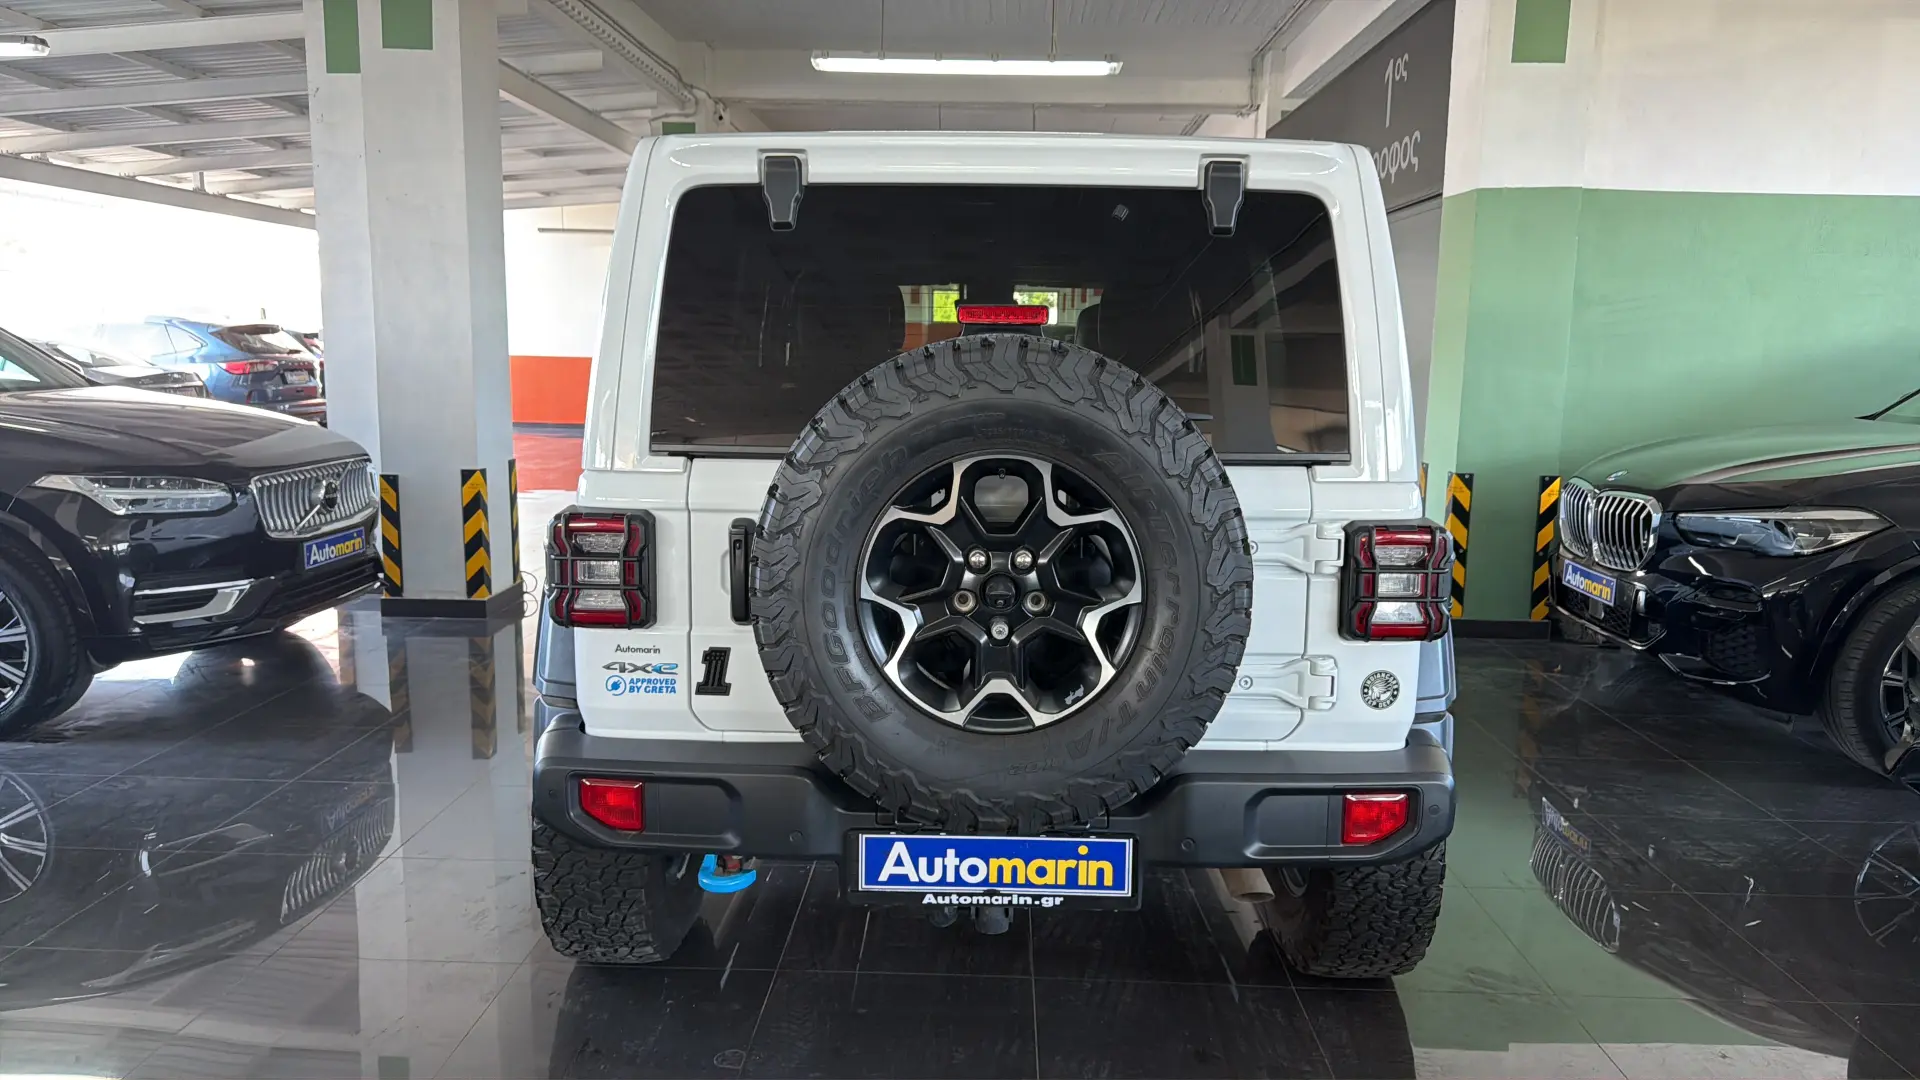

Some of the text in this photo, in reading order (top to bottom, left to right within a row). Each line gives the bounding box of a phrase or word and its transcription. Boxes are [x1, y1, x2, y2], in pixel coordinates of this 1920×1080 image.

[310, 534, 362, 565] Automarin
[1565, 565, 1611, 601] Automarin
[614, 644, 661, 655] Automarin
[628, 678, 677, 686] APPROVED
[628, 686, 677, 694] BY GRETA
[877, 841, 1113, 887] Automarin
[922, 893, 1063, 907] Automarin.gr
